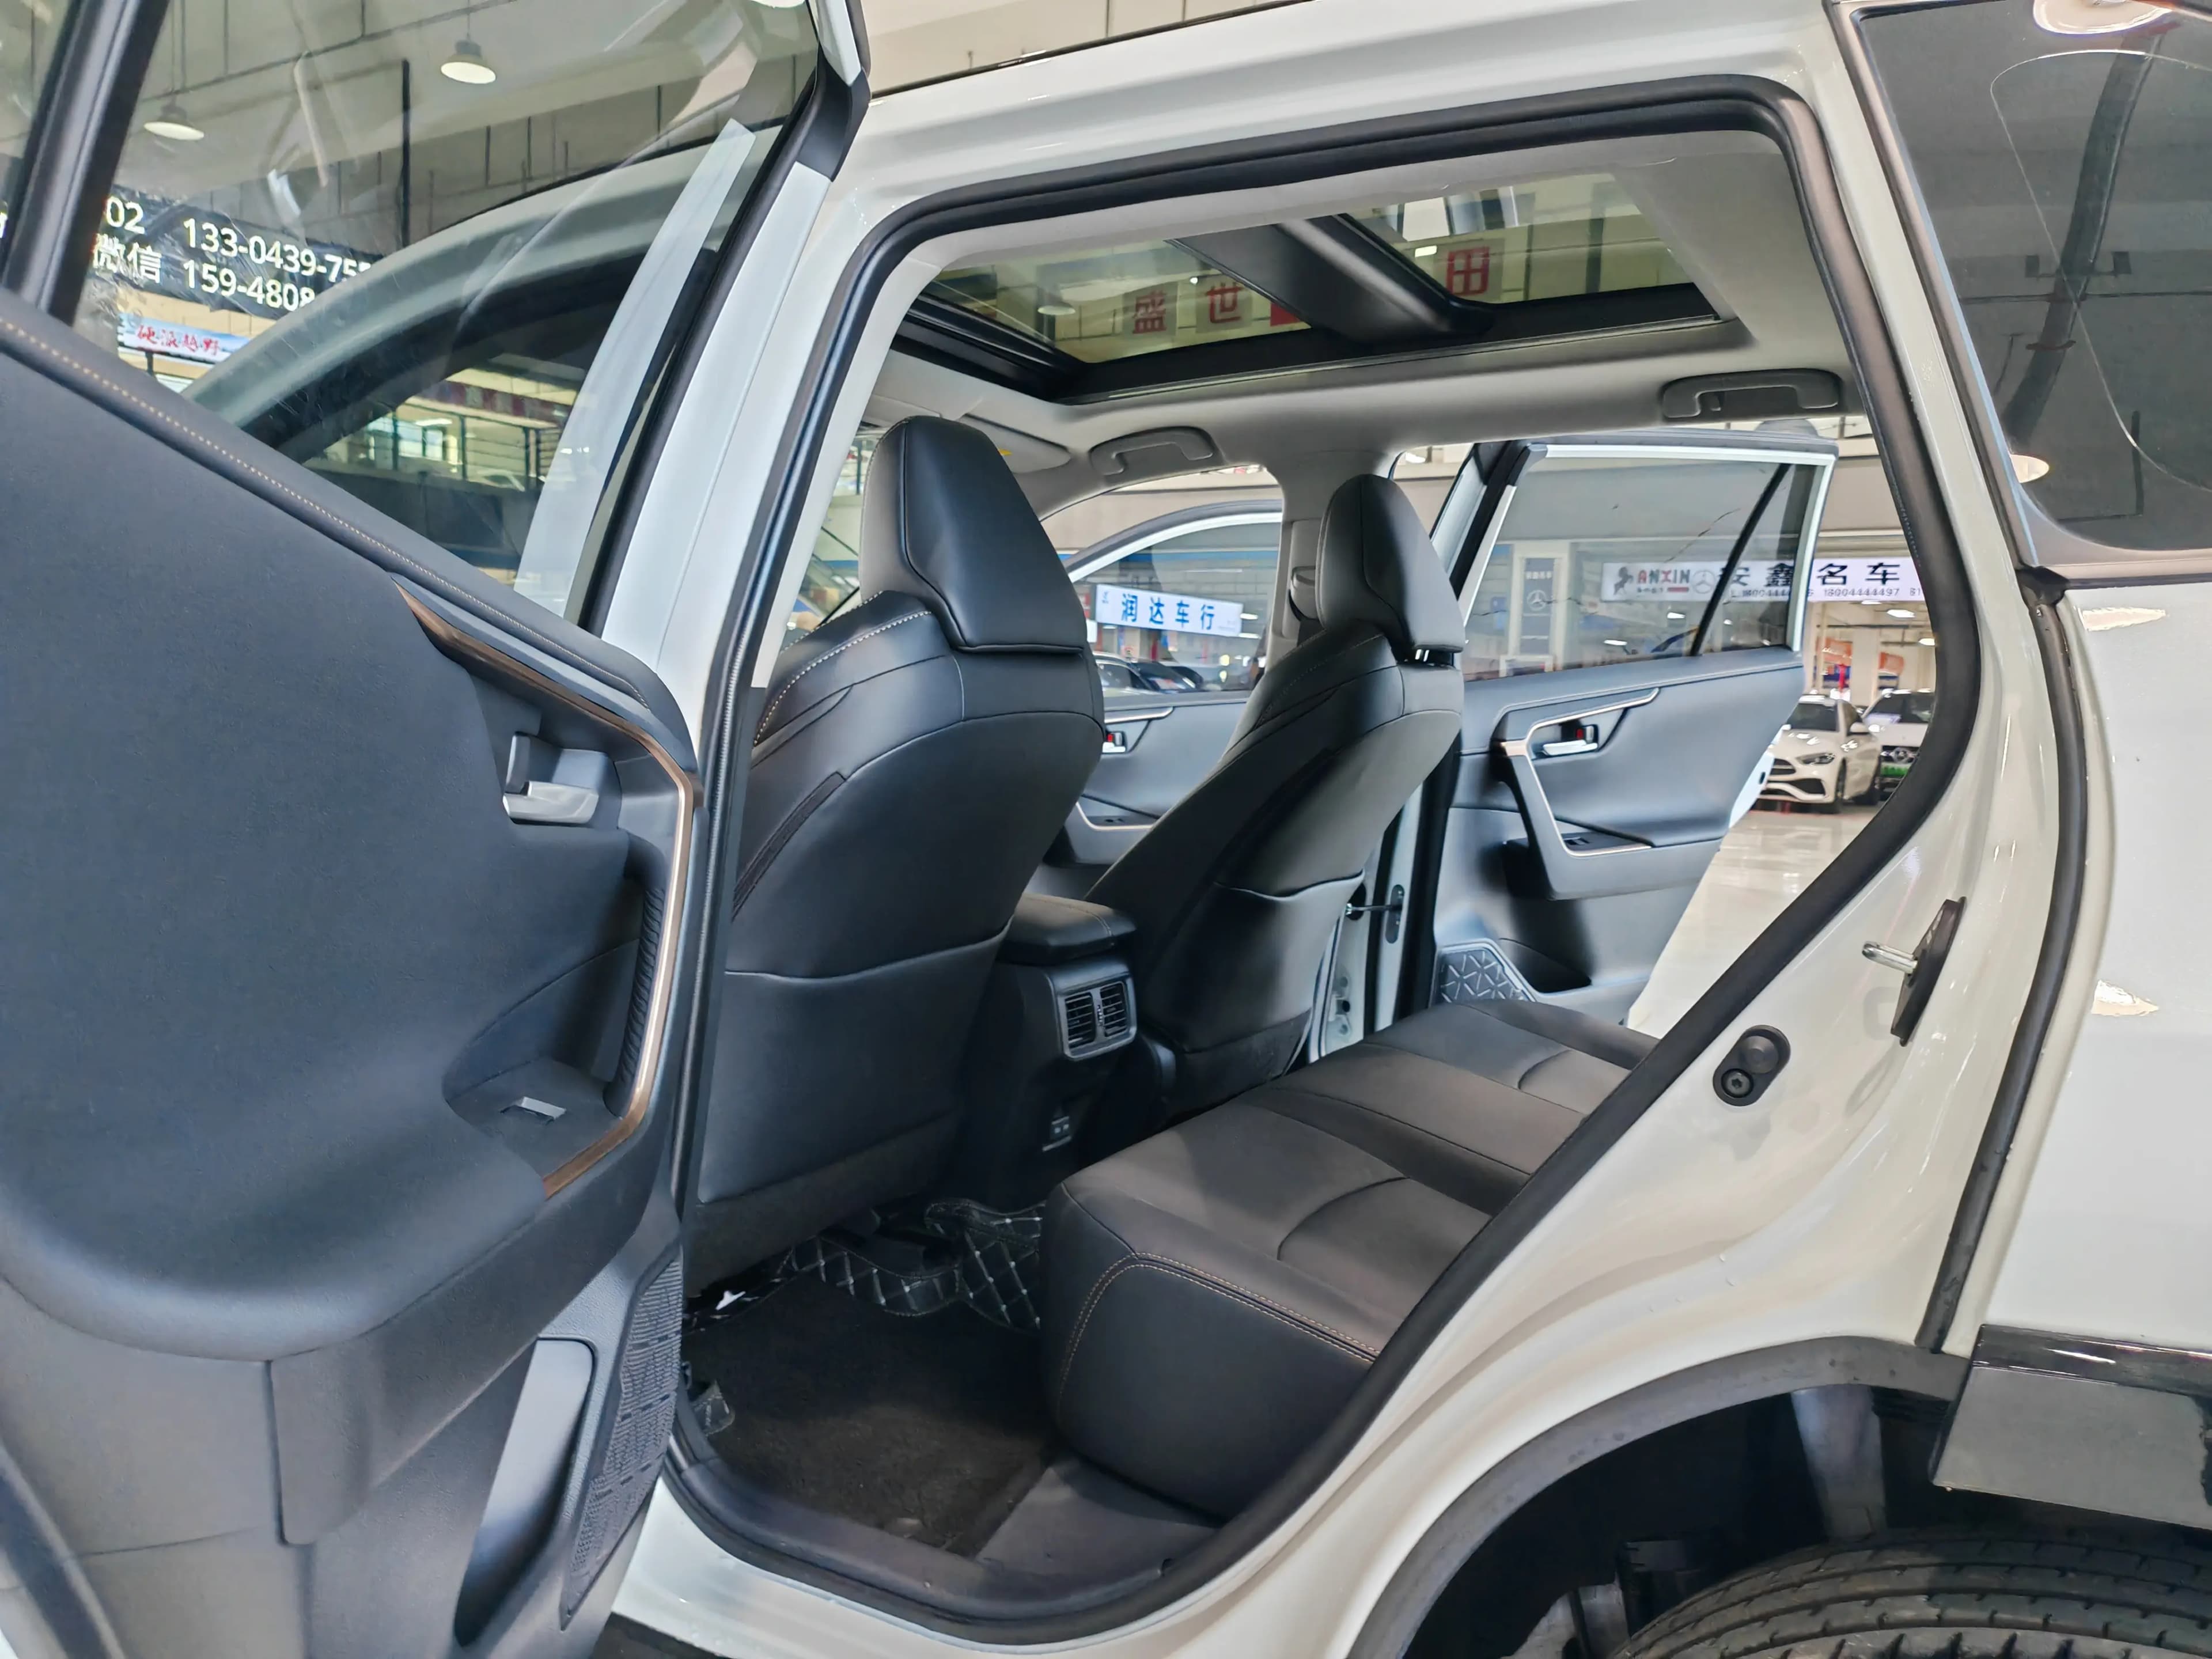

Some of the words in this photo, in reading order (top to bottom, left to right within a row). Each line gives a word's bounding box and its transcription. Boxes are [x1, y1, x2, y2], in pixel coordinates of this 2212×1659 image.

[92, 233, 162, 283] 微信
[1637, 569, 1691, 584] ANXIN
[1719, 562, 1900, 586] 安鑫名车
[1121, 593, 1215, 630] 润达车行
